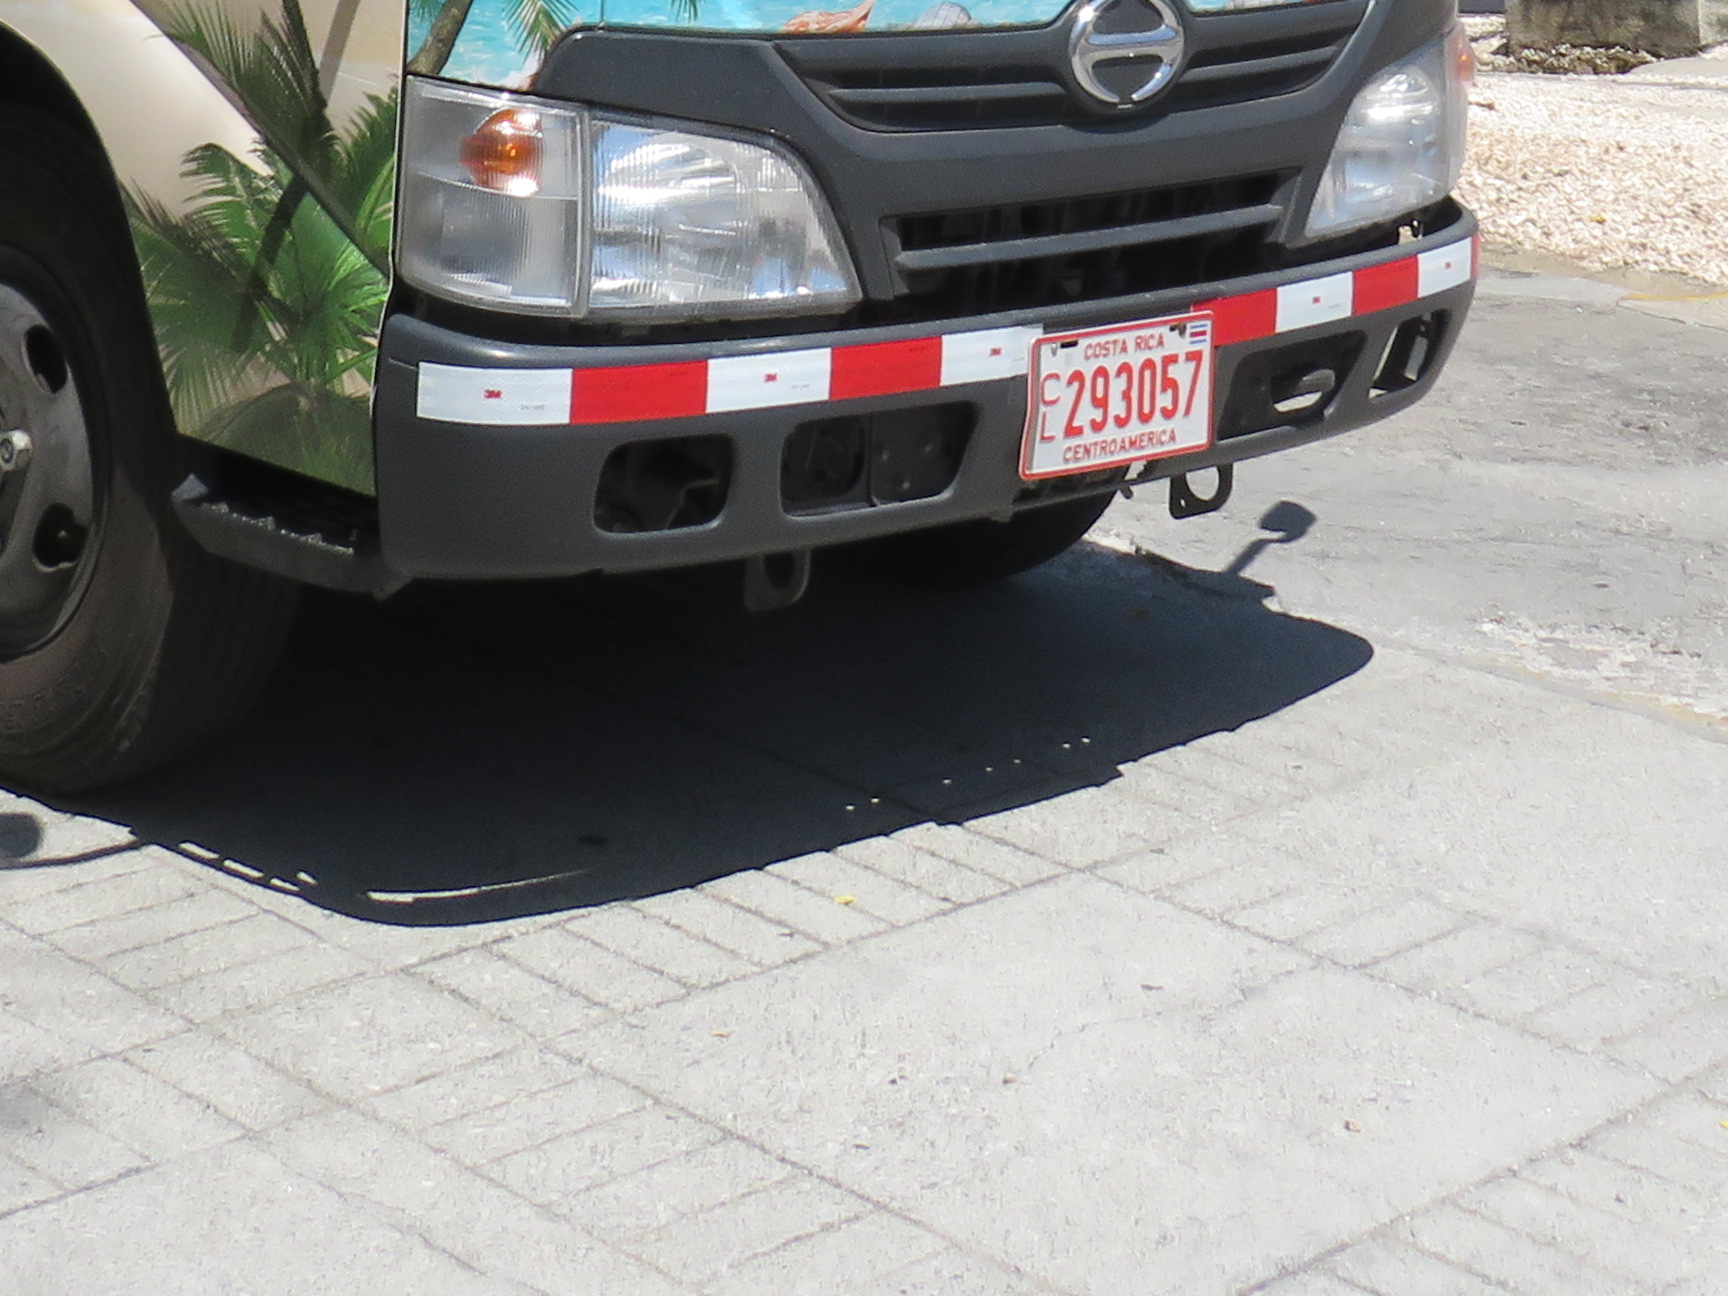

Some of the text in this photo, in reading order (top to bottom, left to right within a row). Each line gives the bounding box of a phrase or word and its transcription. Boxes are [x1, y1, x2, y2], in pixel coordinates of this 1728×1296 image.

[1083, 332, 1165, 361] COSTA RICA
[1063, 348, 1204, 440] 293057
[1062, 427, 1178, 463] CENTROAMERICA
